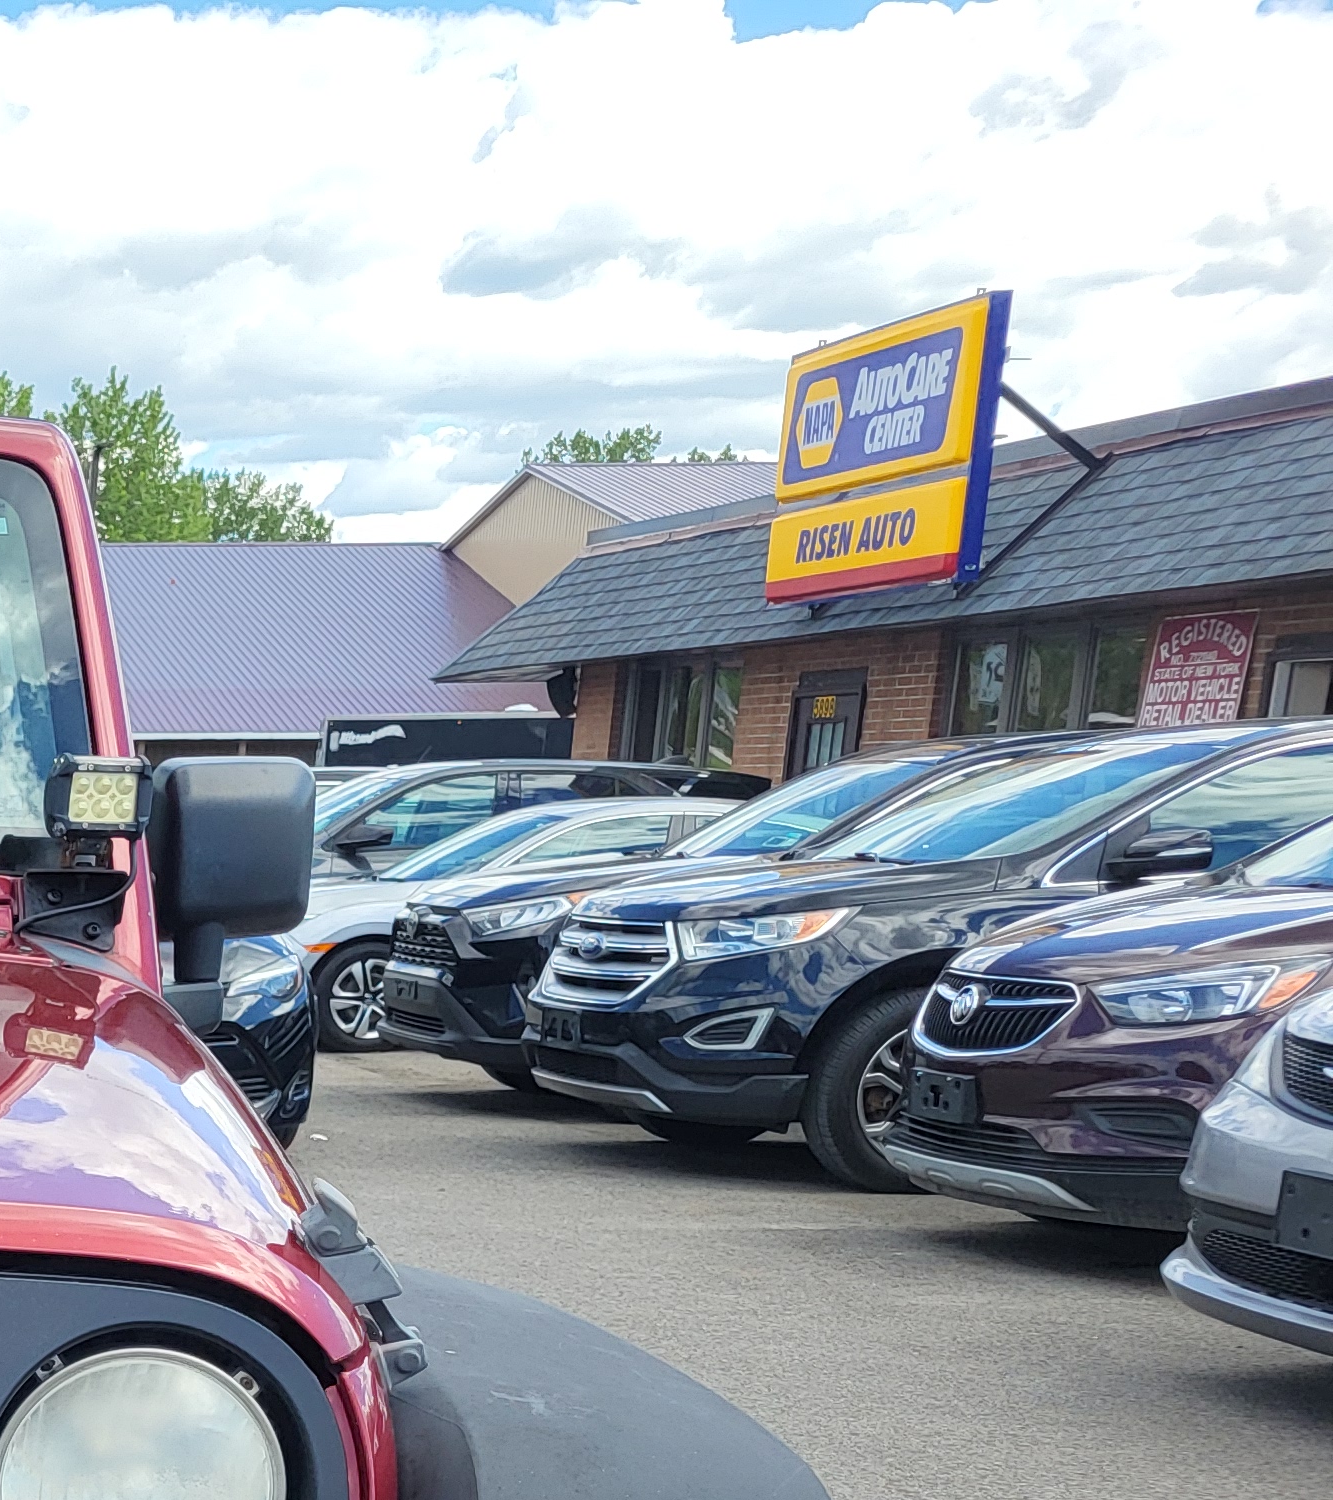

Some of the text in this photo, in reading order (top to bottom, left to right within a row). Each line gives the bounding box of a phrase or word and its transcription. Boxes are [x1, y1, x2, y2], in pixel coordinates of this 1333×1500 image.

[803, 400, 836, 447] NAPA
[864, 405, 924, 454] CENTER
[795, 507, 915, 564] RISEN AUTO
[1160, 619, 1247, 663] REGISTERED
[1146, 677, 1241, 703] MOTOR VEHICLE
[1154, 662, 1241, 680] STATE OF NEW YORK
[1142, 701, 1236, 727] RETAIL DEALER
